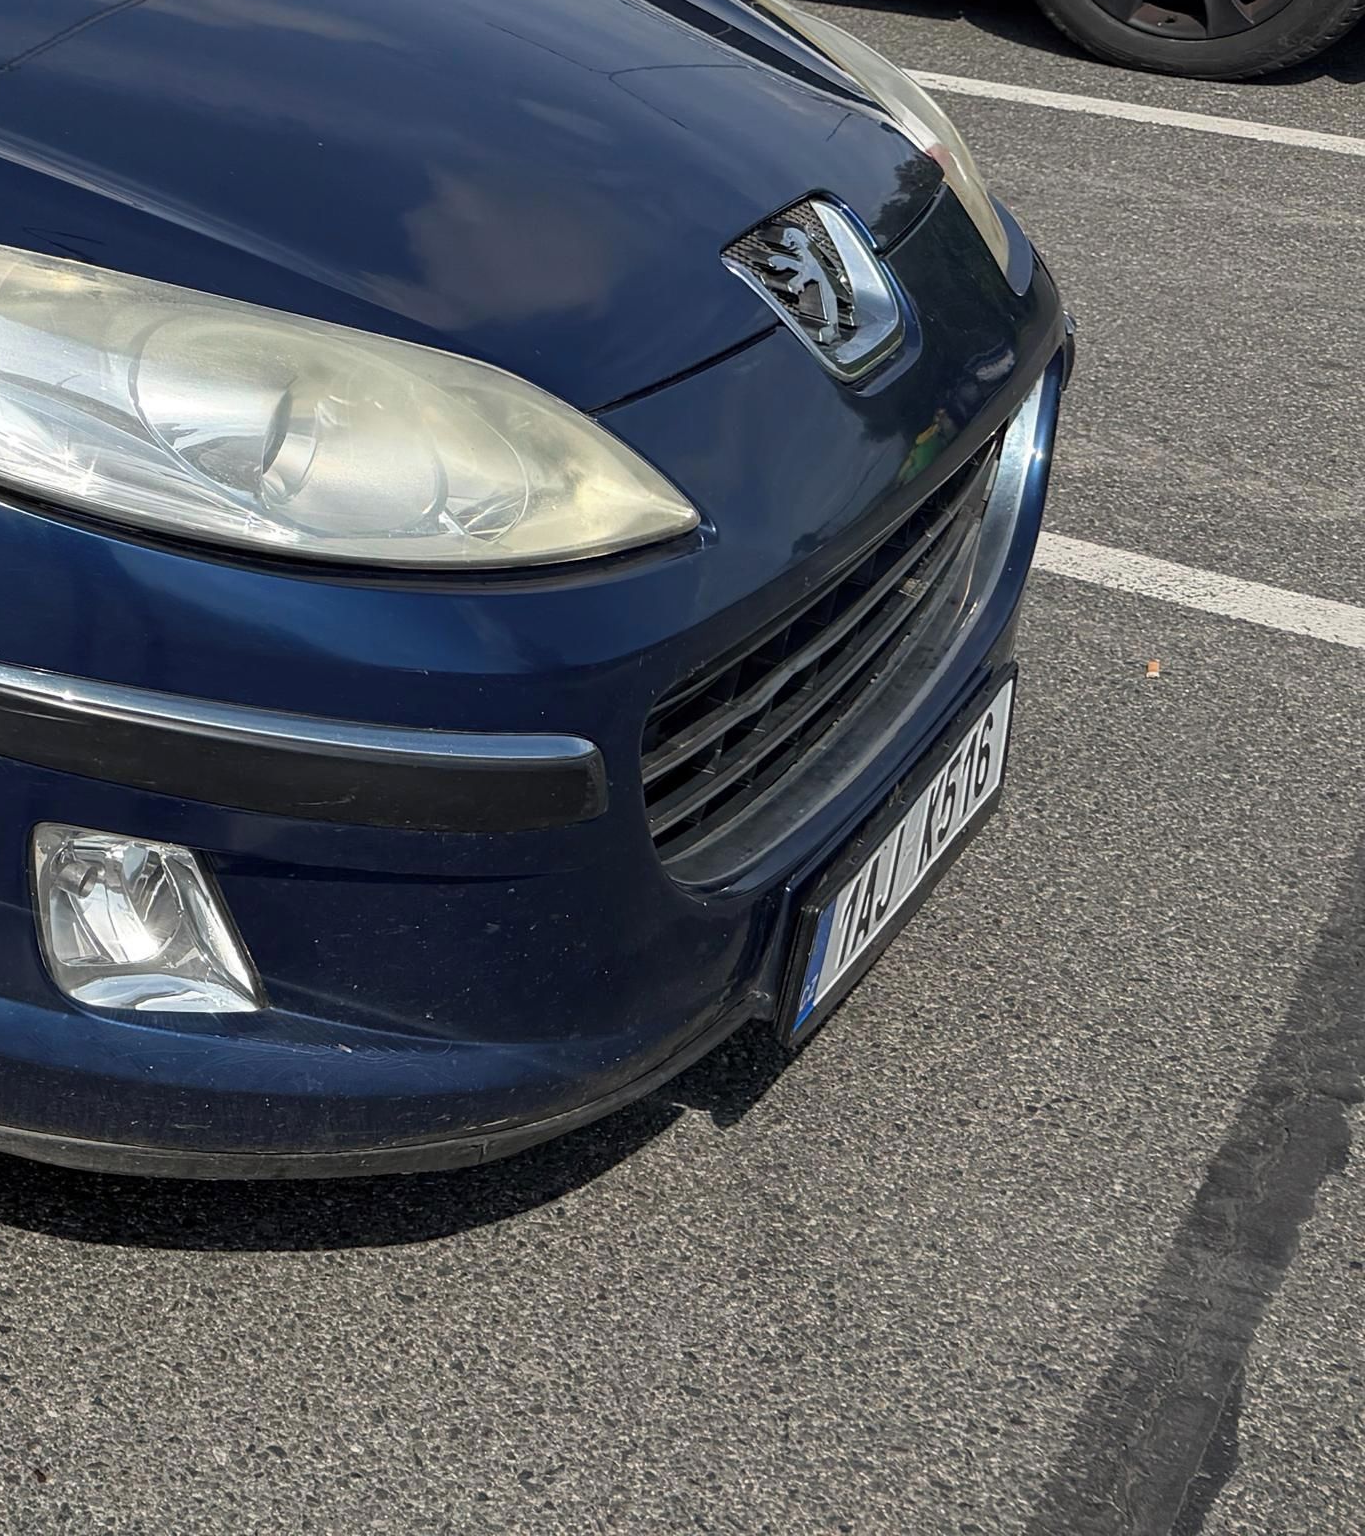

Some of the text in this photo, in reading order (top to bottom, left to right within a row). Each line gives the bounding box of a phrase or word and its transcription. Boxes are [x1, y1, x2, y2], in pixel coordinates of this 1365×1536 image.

[837, 712, 994, 970] 1AJ K516
[799, 972, 819, 1012] CZ
